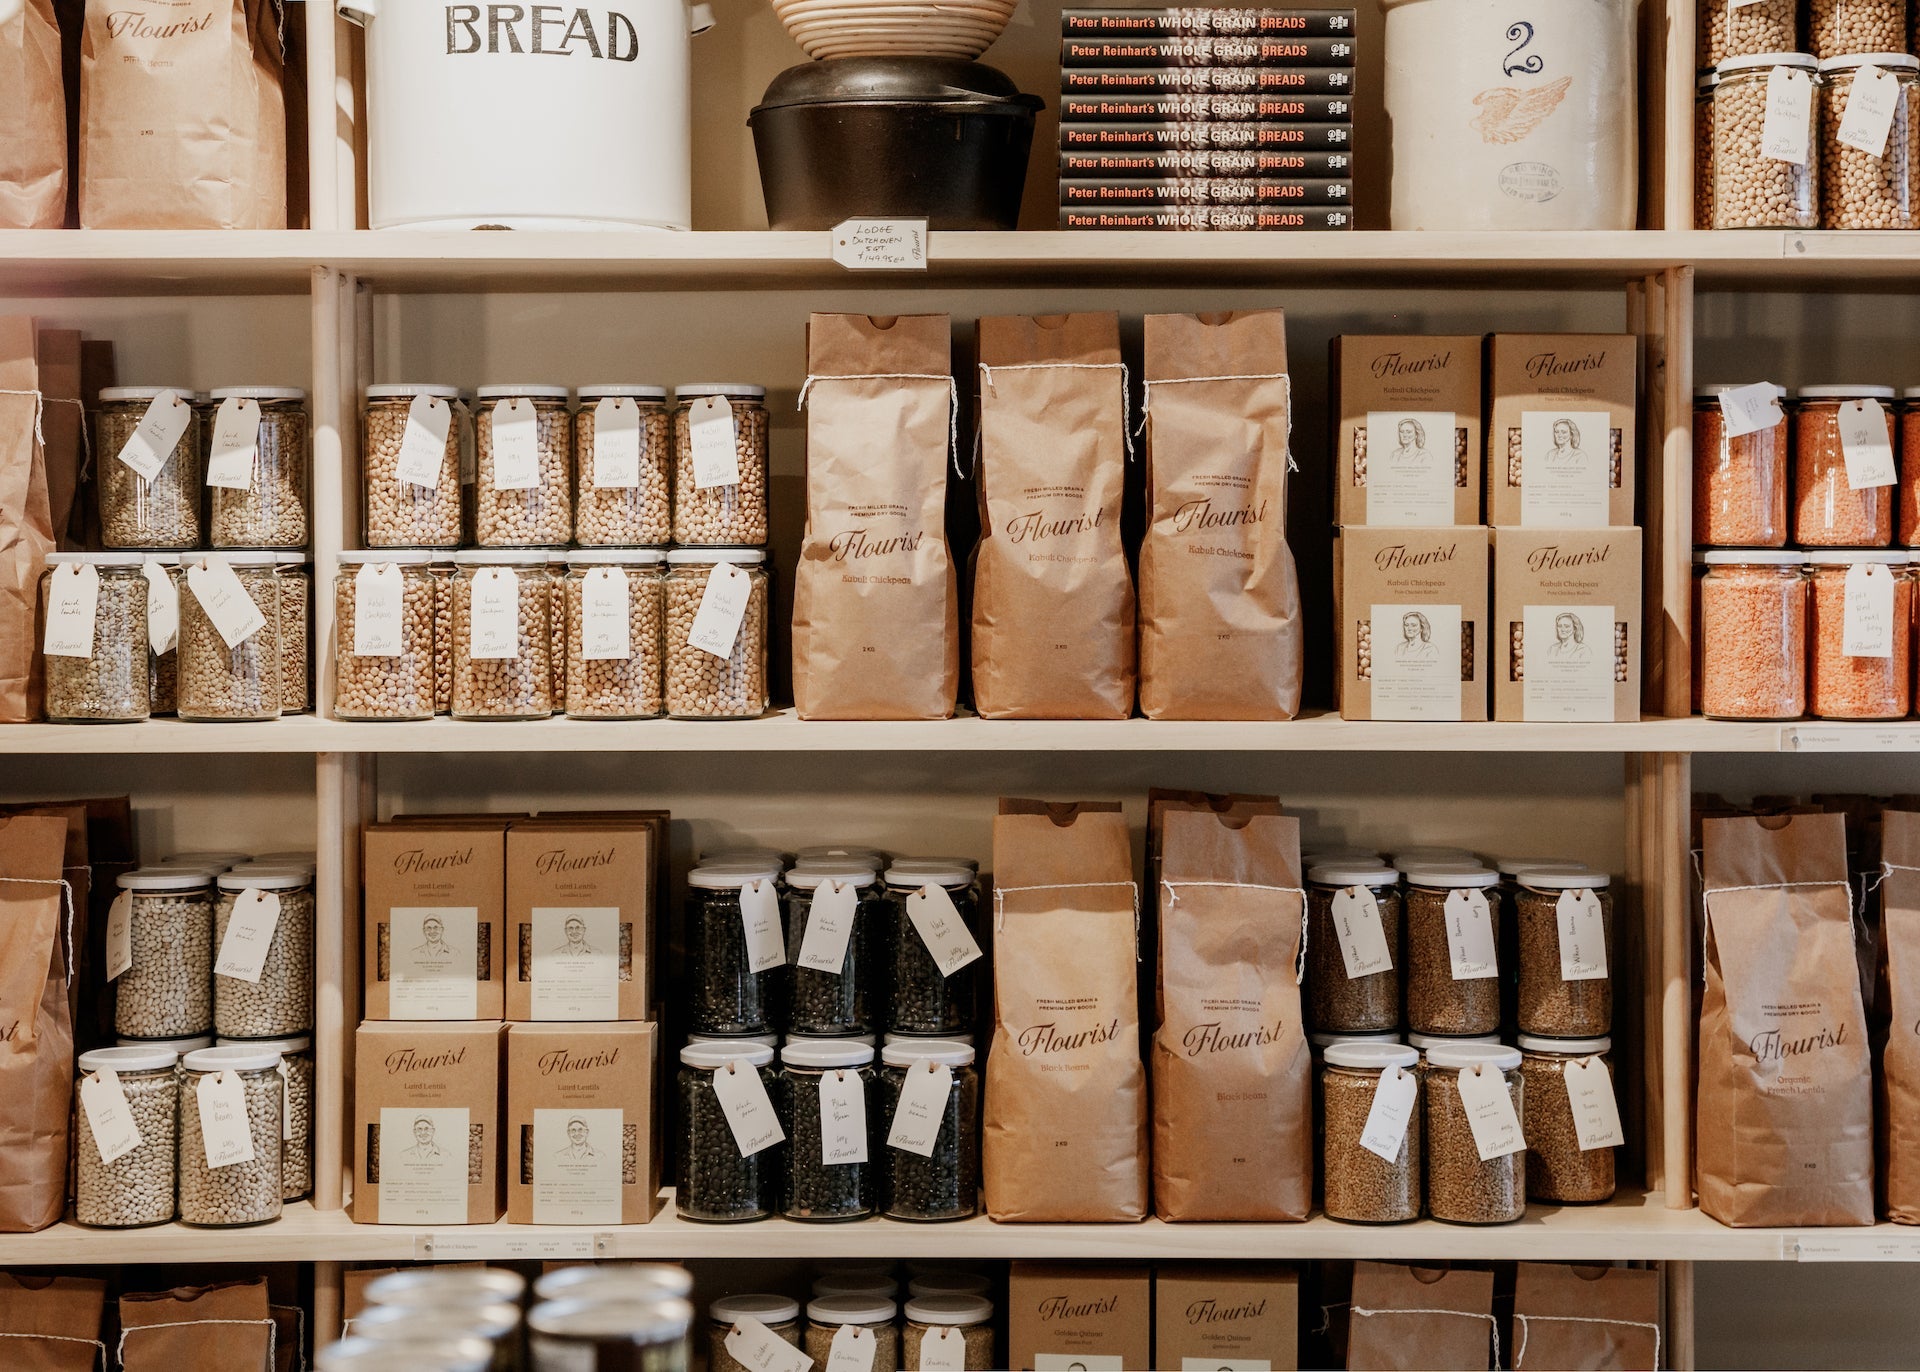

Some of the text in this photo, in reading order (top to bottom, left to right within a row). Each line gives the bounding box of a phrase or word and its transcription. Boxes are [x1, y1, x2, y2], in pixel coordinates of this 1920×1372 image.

[106, 11, 216, 39] Flourist
[445, 4, 639, 62] BREAD
[1070, 17, 1305, 28] Peter Reinhart's WHOLE GRAIN BREADS
[1072, 45, 1307, 56] Peter Reinhart's WHOLE GRAIN BREADS
[1503, 21, 1543, 77] 2
[1070, 74, 1305, 86] Peter Reinhart's WHOLE GRAIN BREADS
[1070, 103, 1304, 114] Peter Reinhart's WHOLE GRAIN BREADS
[1069, 131, 1304, 143] Peter Reinhart's WHOLE GRAIN BREADS
[1069, 157, 1304, 168] Peter Reinhart's WHOLE GRAIN BREADS
[1069, 186, 1304, 198] Peter Reinhart's WHOLE GRAIN BREADS
[856, 224, 893, 234] LODGE
[1068, 214, 1304, 226] Peter Reinhart's WHOLE GRAIN BREADS
[1371, 352, 1451, 379] Flourist
[1525, 351, 1606, 379] Flourist
[1006, 507, 1104, 543] Flourist
[1173, 497, 1267, 533] Flourist
[829, 528, 926, 562] Flourist
[1375, 544, 1457, 572] Flourist
[1527, 544, 1612, 573] Flourist
[869, 575, 911, 585] Chickpeas
[1410, 579, 1446, 588] Chickpeas
[1563, 580, 1599, 589] Chickpeas
[394, 847, 473, 875] Flourist
[536, 847, 616, 876] Flourist
[1018, 1018, 1120, 1057] Flourist
[1183, 1020, 1285, 1057] Flourist
[1750, 1023, 1848, 1064] Flourist
[385, 1046, 467, 1075] Flourist
[538, 1047, 620, 1077] Flourist
[1041, 1064, 1063, 1072] Black
[1038, 1295, 1119, 1321] Flourist
[1185, 1299, 1267, 1325] Flourist
